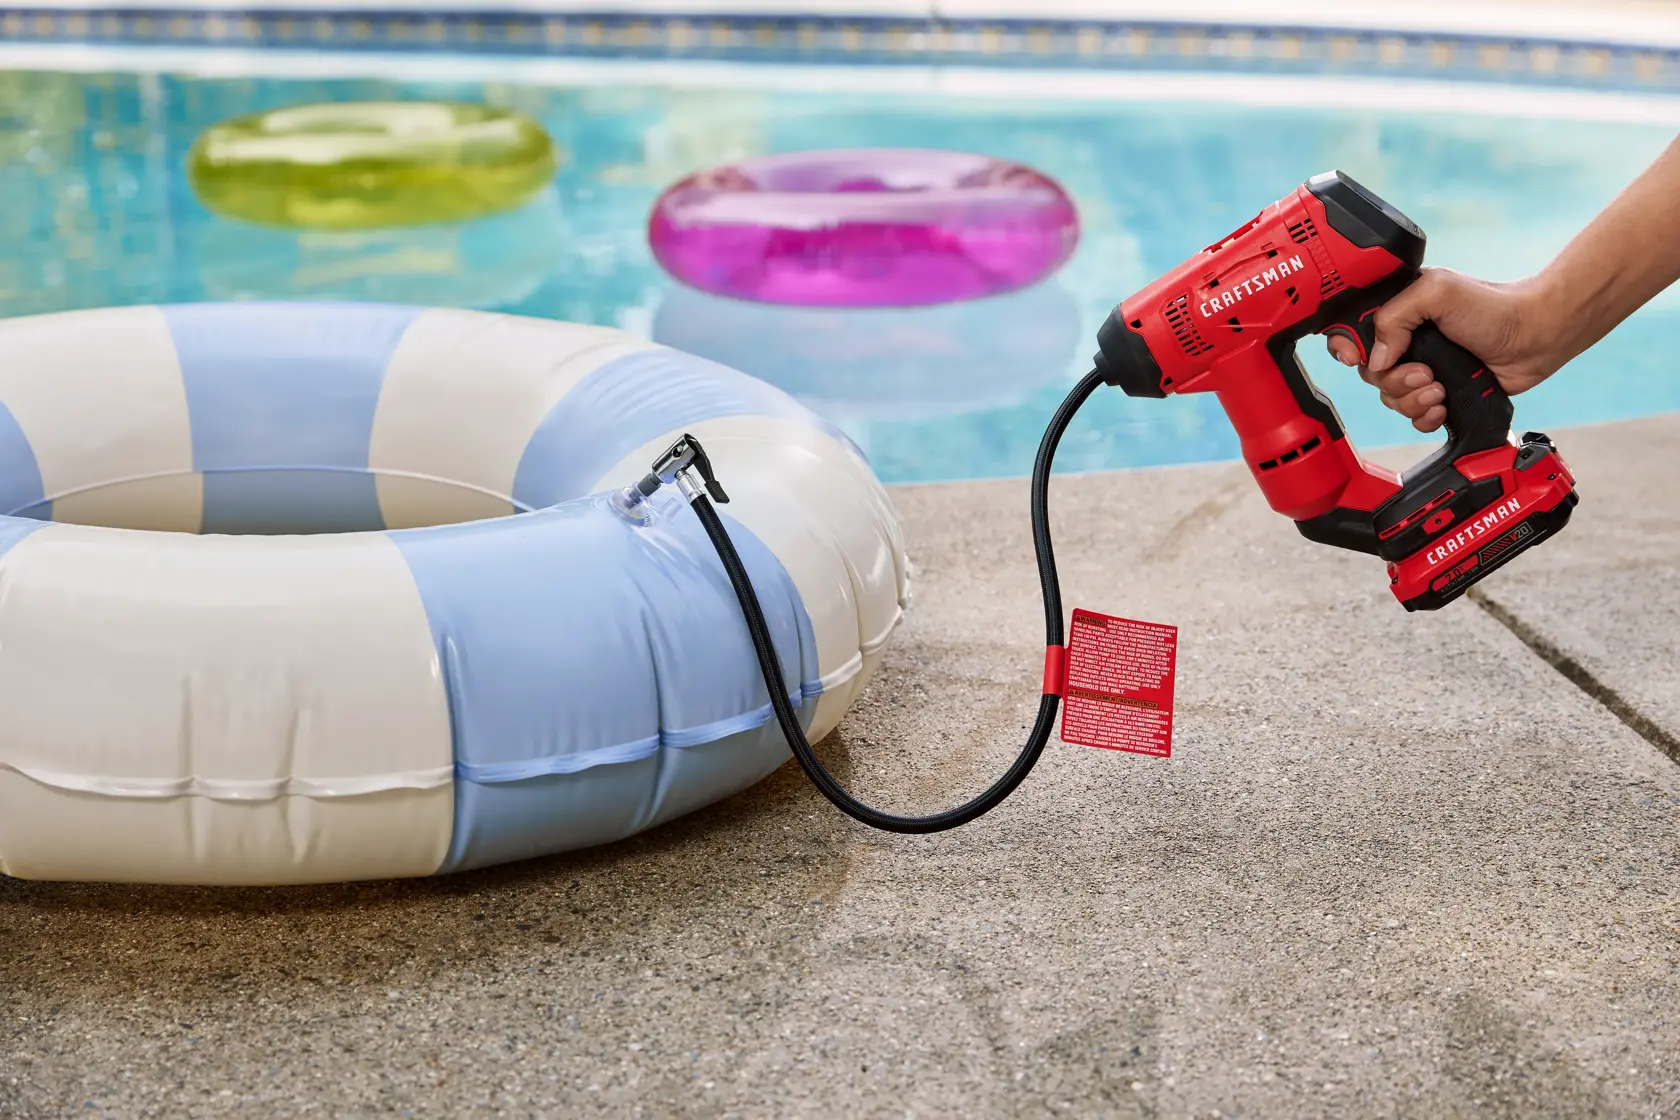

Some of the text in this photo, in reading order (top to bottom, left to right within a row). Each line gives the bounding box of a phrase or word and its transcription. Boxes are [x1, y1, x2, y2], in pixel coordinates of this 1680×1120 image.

[1199, 254, 1305, 318] CRAFTSMAN
[1426, 497, 1521, 565] CRAFTSMAN
[1509, 526, 1530, 542] V20
[1068, 680, 1098, 690] HOUSEHOLD
